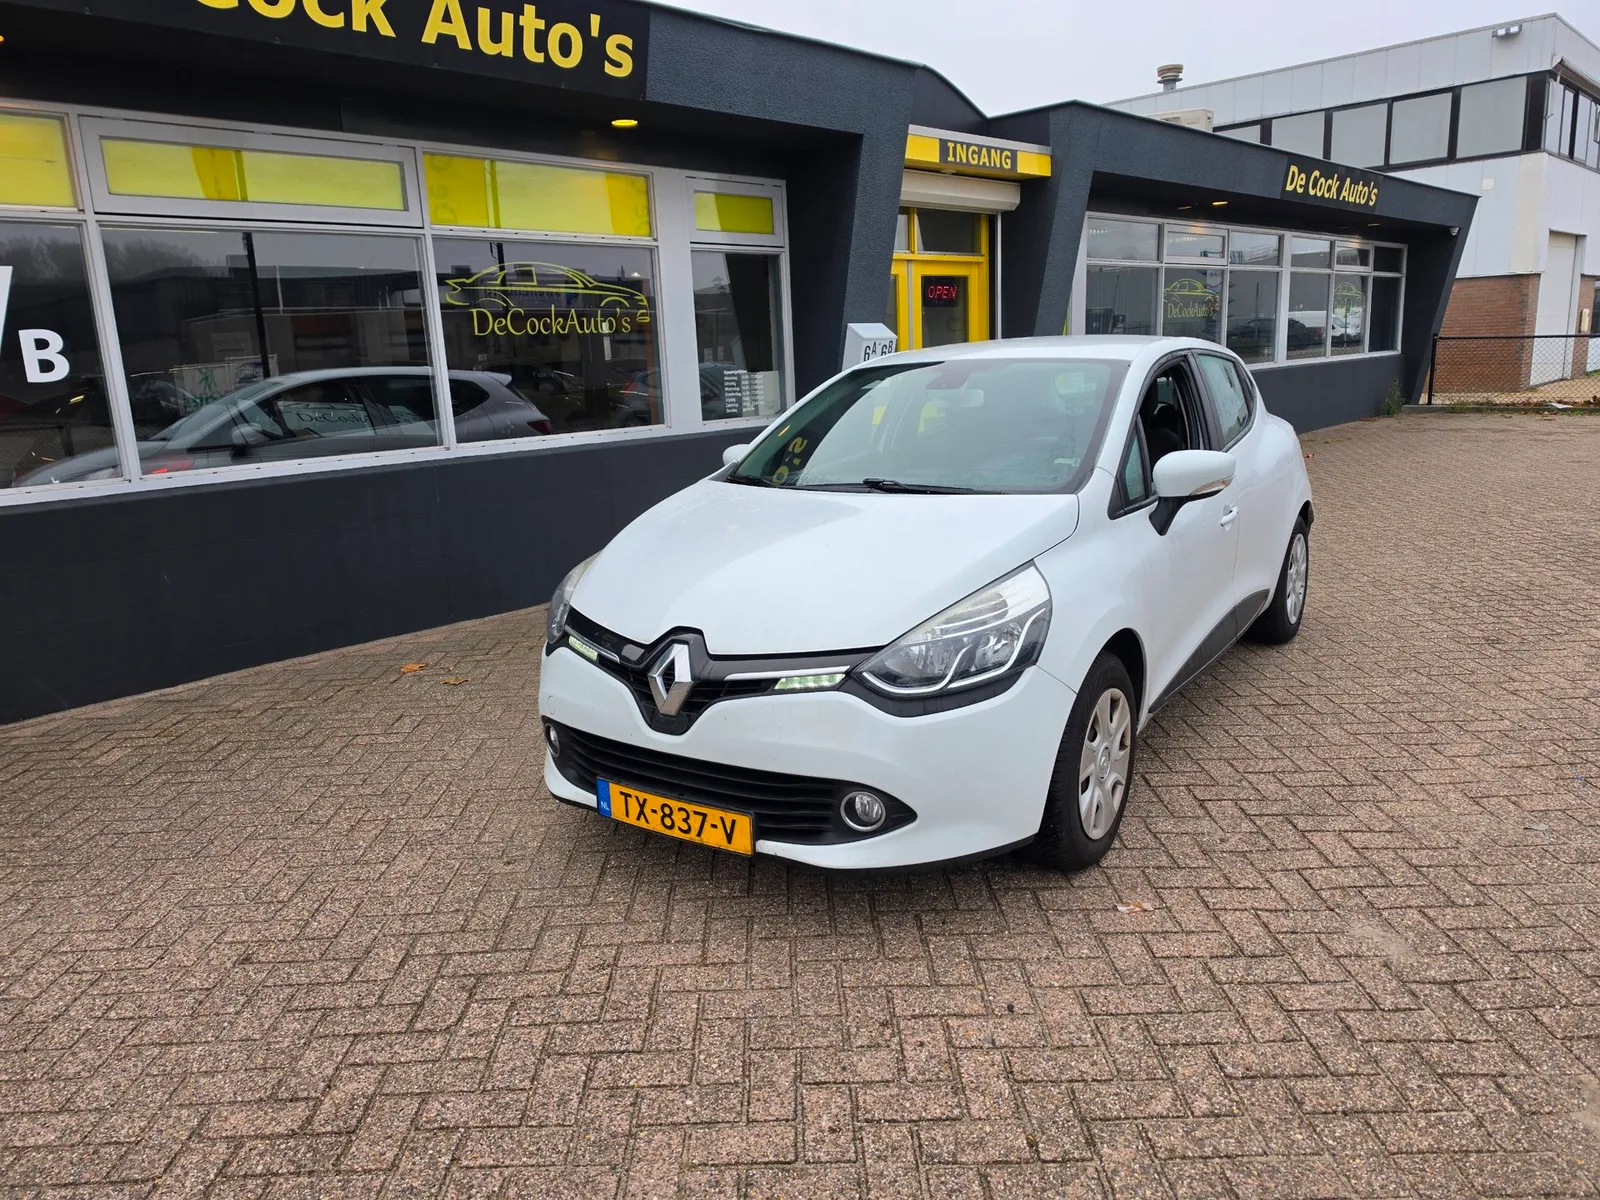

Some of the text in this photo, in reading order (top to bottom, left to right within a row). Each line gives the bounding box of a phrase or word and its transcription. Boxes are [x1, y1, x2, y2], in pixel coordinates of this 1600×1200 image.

[421, 0, 634, 78] Auto's
[947, 142, 1012, 169] INGANG
[1285, 165, 1378, 206] De Cock Auto's
[928, 285, 958, 299] OPEN
[469, 305, 631, 336] DeCockAuto's
[18, 328, 70, 383] B
[600, 790, 736, 845] NL TX-837-V
